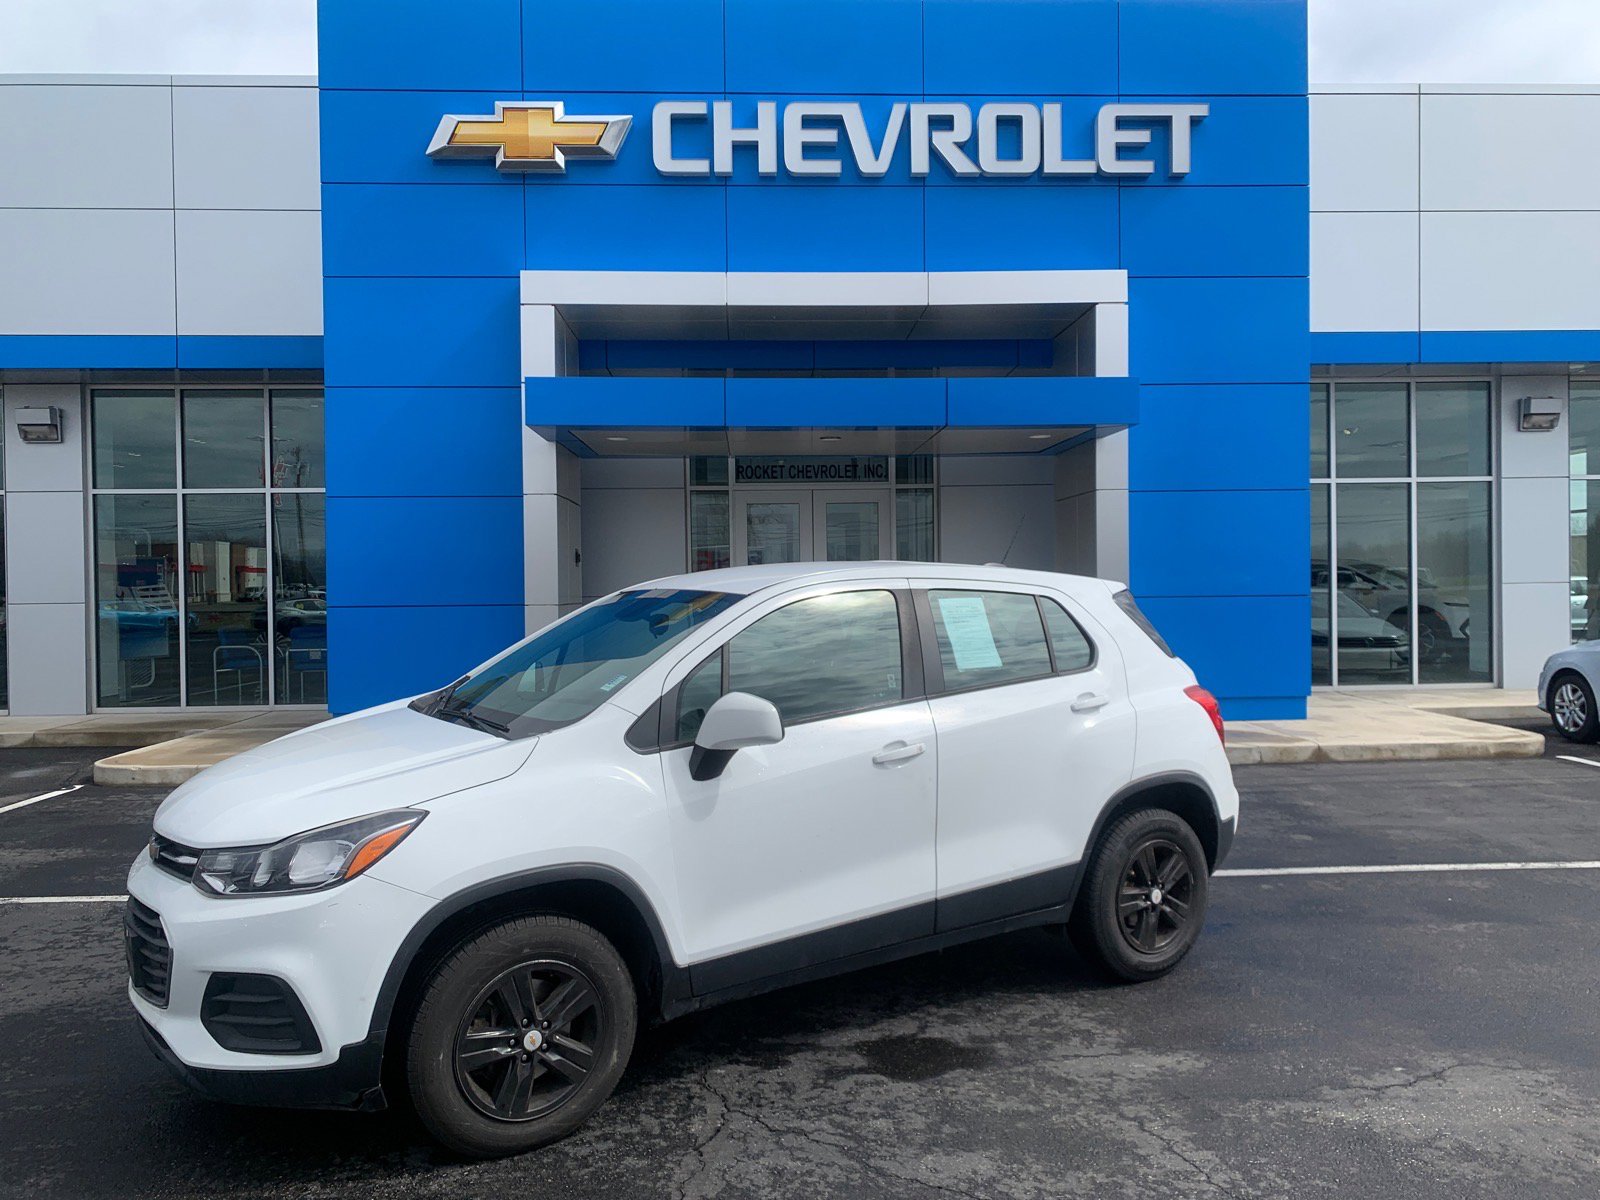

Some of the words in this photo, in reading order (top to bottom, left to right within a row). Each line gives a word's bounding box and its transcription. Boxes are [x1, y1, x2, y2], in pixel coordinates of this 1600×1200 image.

[652, 101, 1210, 177] CHEVROLET
[737, 464, 785, 480] ROCKET
[864, 463, 888, 479] INC.
